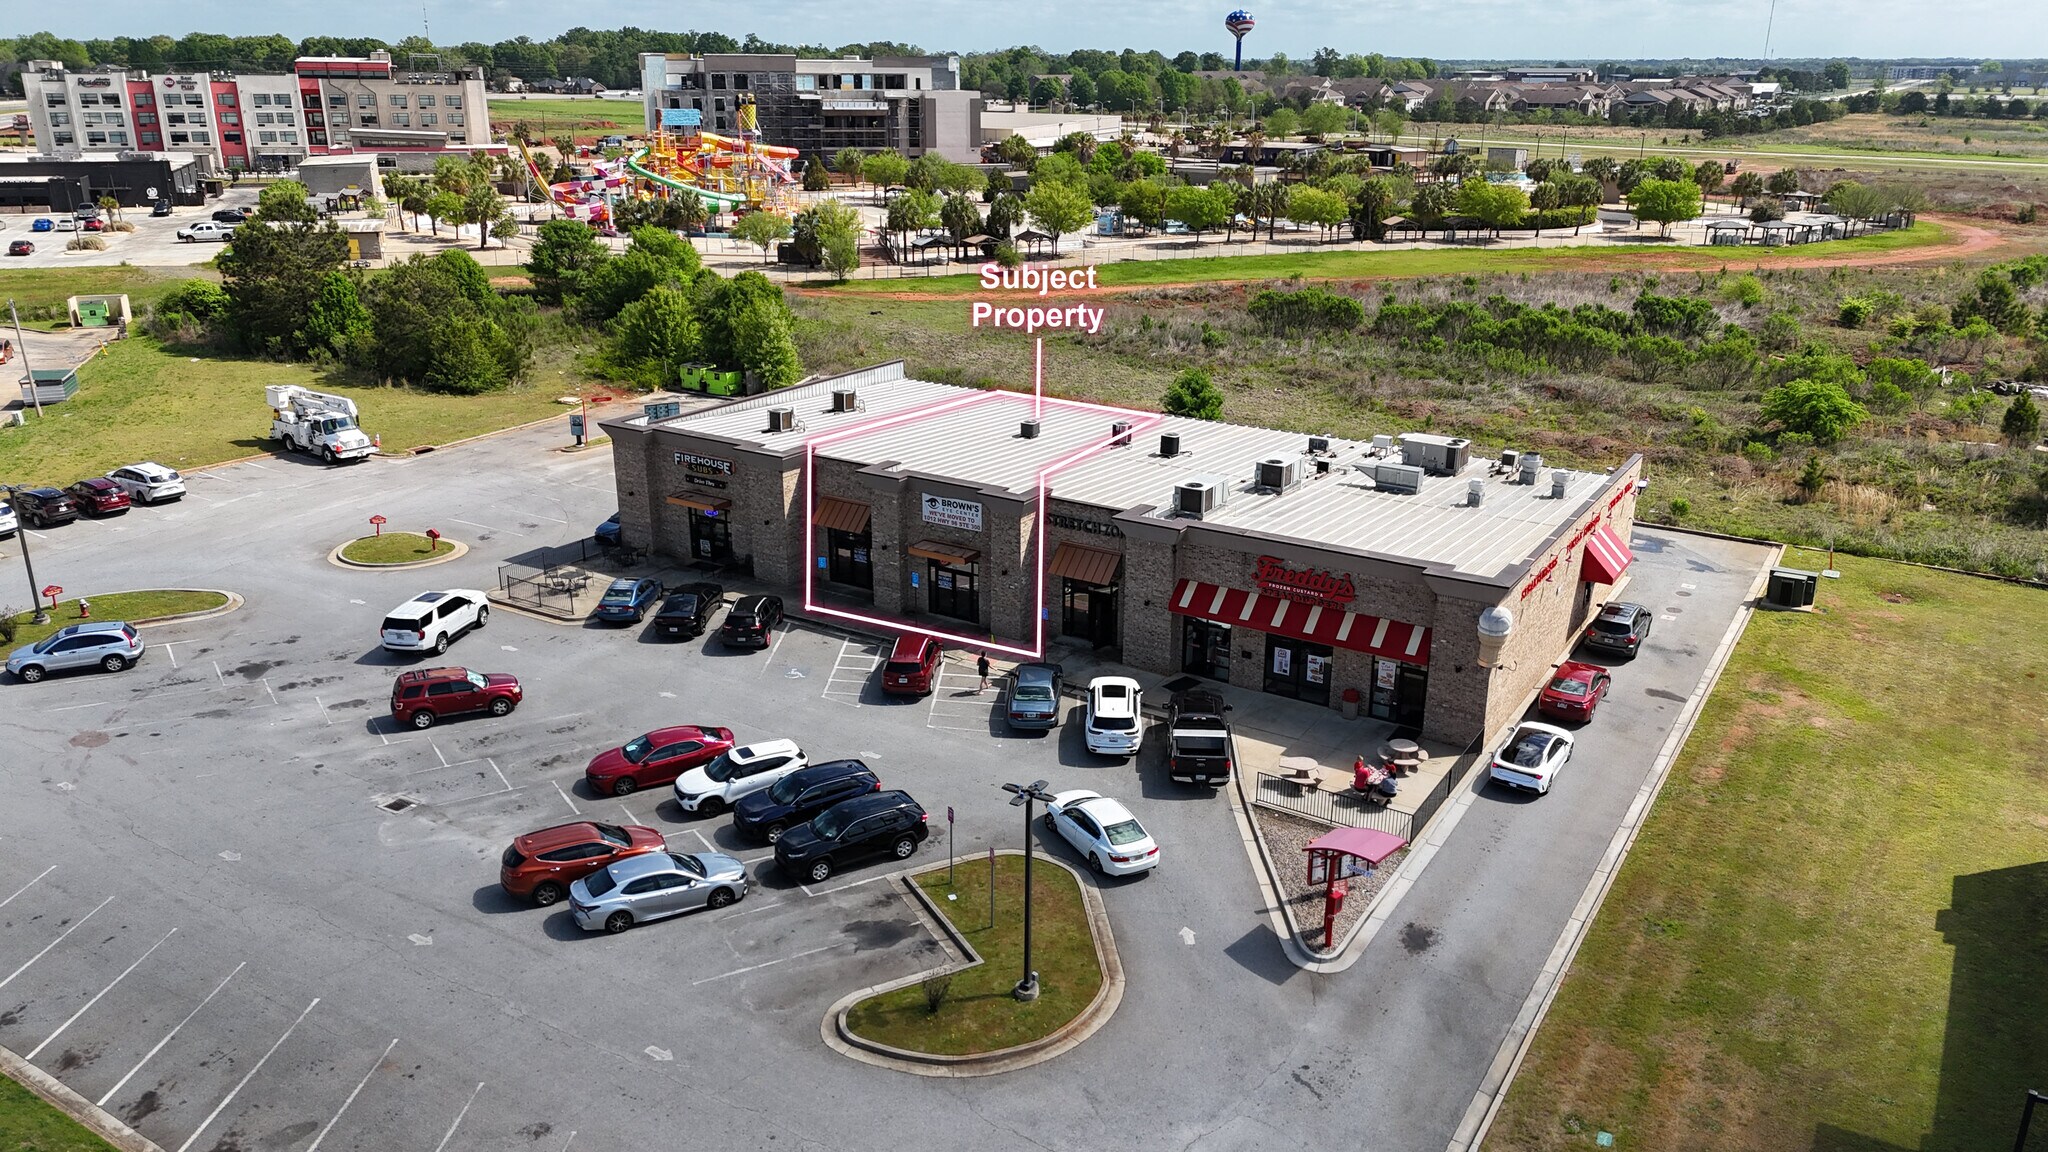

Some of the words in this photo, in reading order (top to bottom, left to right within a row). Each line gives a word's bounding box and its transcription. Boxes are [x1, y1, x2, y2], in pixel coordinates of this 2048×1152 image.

[77, 77, 111, 88] Residency
[674, 453, 731, 474] FIREHOUSE
[691, 465, 714, 474] SUBS
[941, 499, 980, 513] BROWN'S
[946, 513, 967, 522] MOVED
[956, 509, 979, 518] CENTER
[1045, 513, 1101, 535] STRETCH
[1251, 555, 1355, 603] Freddy's
[1268, 582, 1291, 591] FROZEN
[1292, 587, 1319, 597] CUSTARD
